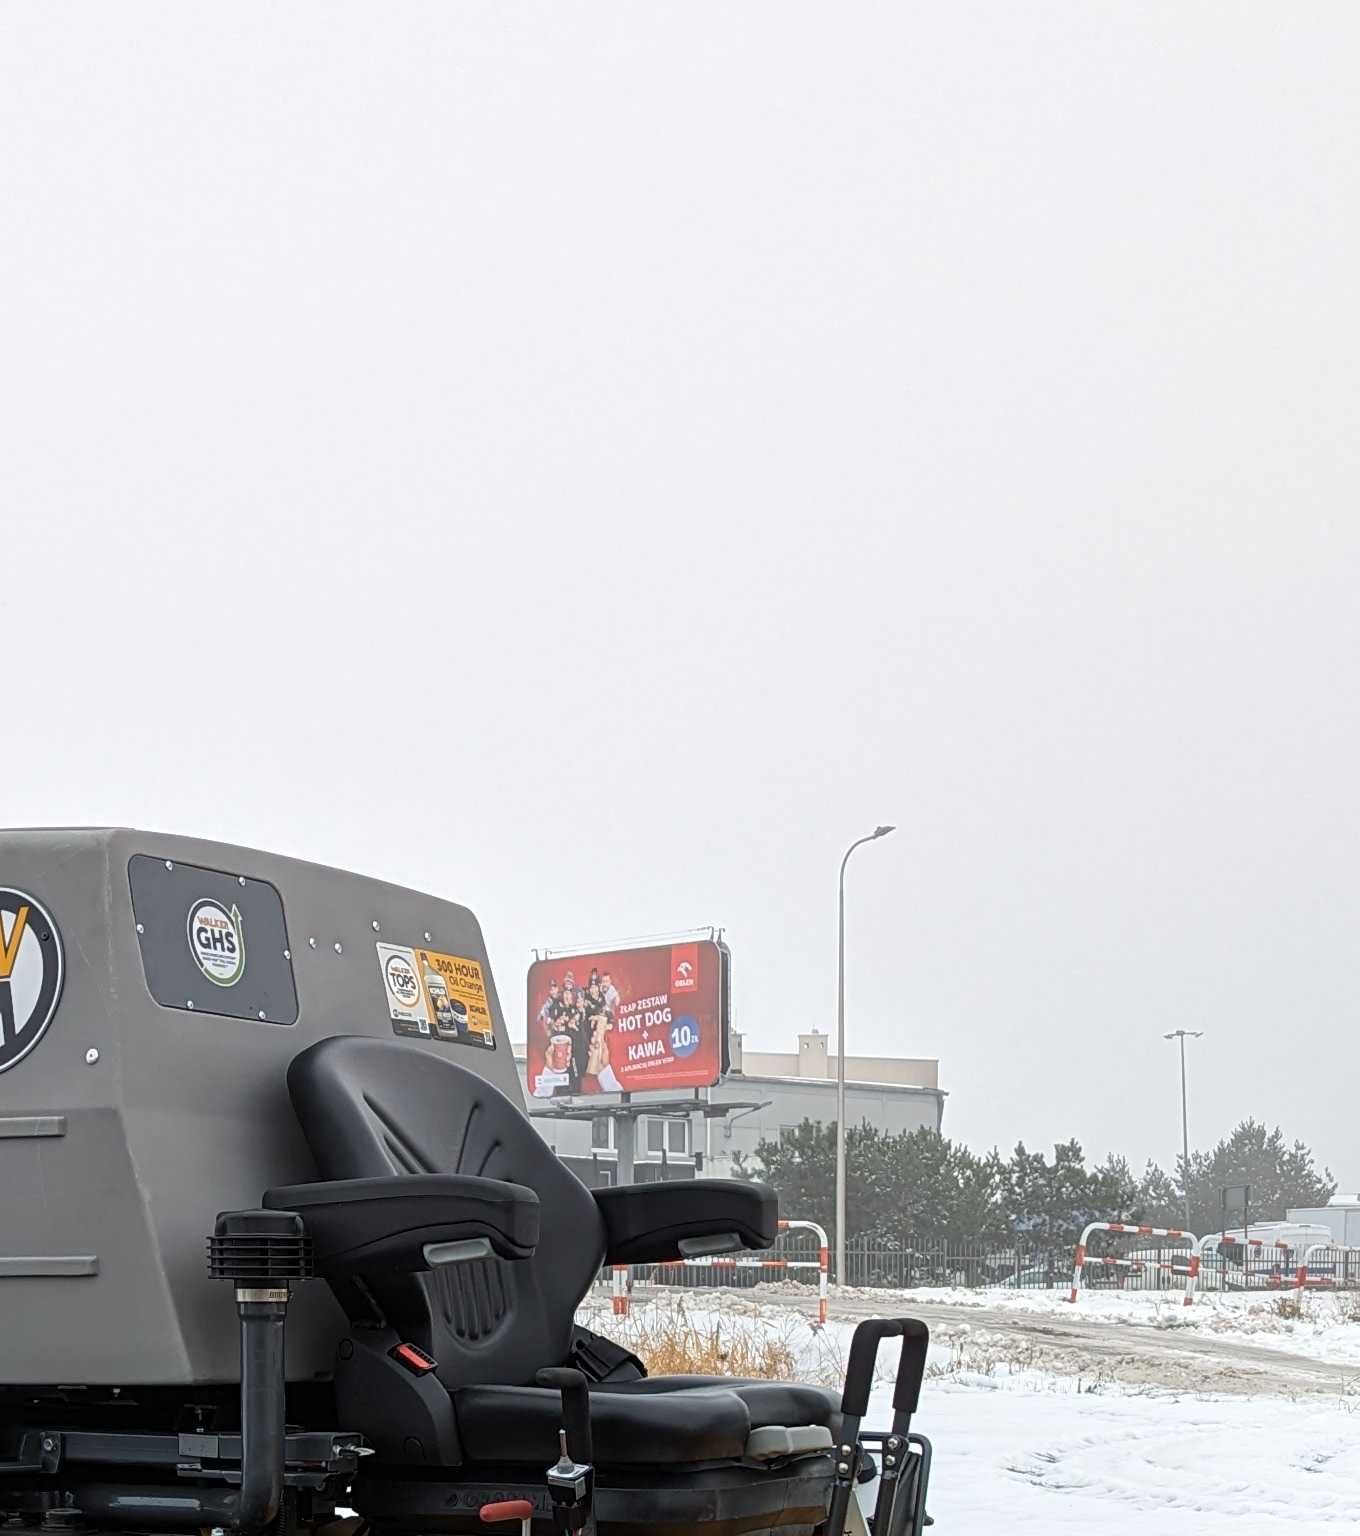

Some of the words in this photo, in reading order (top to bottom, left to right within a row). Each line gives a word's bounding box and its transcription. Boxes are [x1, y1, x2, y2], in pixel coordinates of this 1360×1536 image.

[196, 927, 236, 954] GHS
[454, 963, 480, 979] HOUR
[389, 973, 416, 990] TOPS
[449, 976, 459, 986] Oil
[459, 978, 483, 993] Change
[637, 994, 668, 1010] ZESTAW
[618, 1014, 642, 1033] HOT
[645, 1008, 672, 1027] DOG
[672, 1025, 691, 1049] 10
[628, 1039, 665, 1061] KAWA
